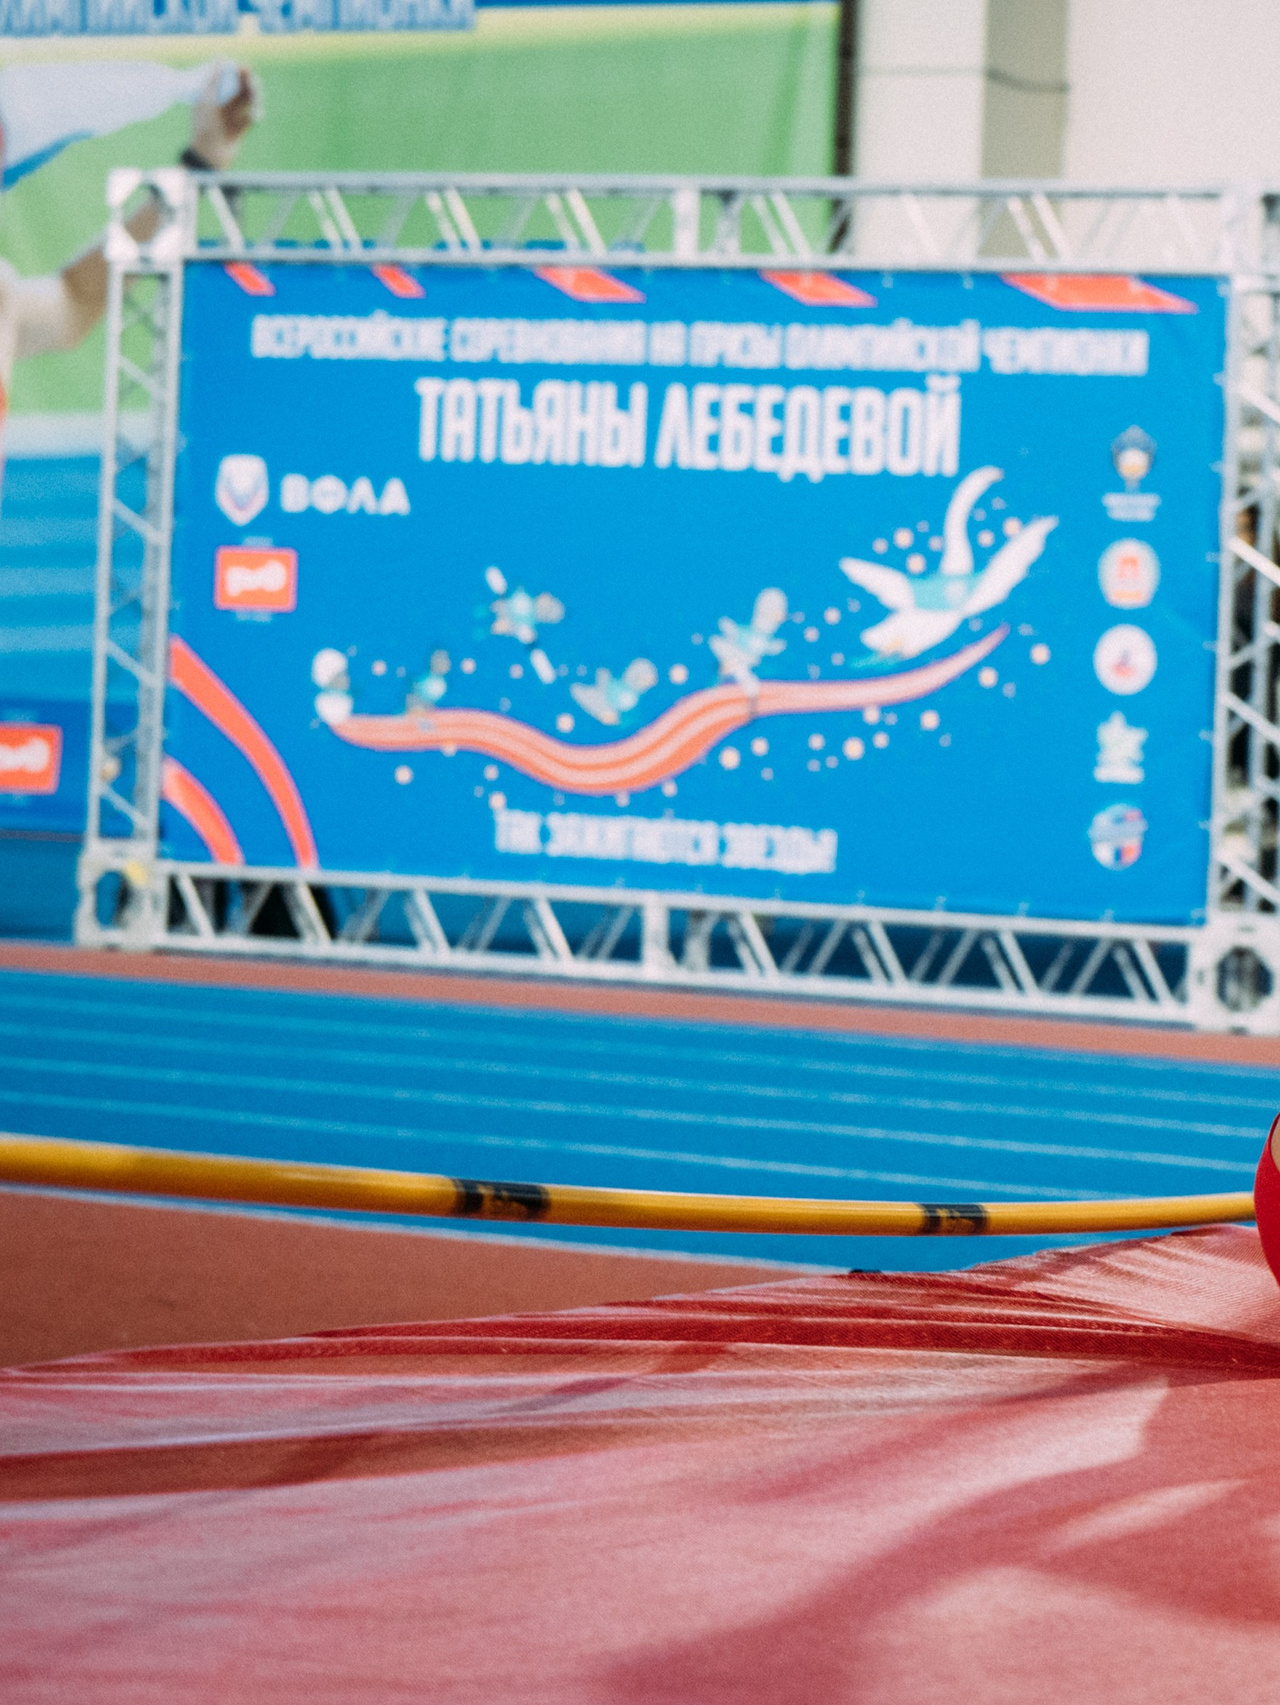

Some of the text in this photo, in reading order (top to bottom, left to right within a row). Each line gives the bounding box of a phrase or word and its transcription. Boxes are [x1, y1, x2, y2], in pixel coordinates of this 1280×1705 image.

[415, 374, 961, 483] ТАТЬЯНЫ ЛЕБЕДЕВОЙ
[280, 473, 410, 516] ВФЛА
